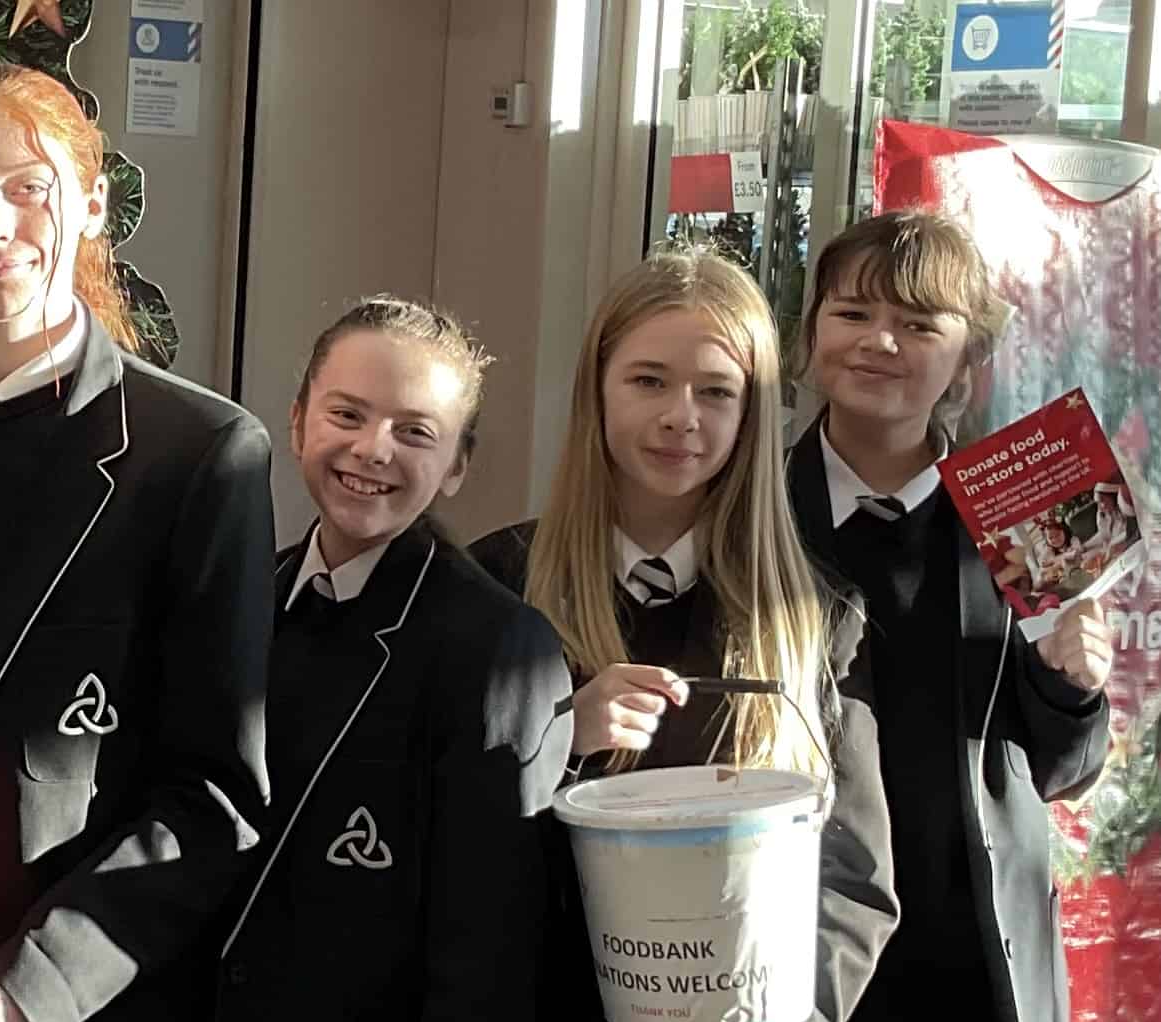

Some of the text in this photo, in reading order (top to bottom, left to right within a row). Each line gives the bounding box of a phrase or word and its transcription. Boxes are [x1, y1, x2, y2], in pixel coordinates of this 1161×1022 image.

[735, 181, 761, 197] £3.50
[957, 428, 1045, 482] Donate food
[1025, 438, 1070, 465] today.
[602, 933, 715, 960] FOODBANK
[667, 964, 768, 993] WELCOM
